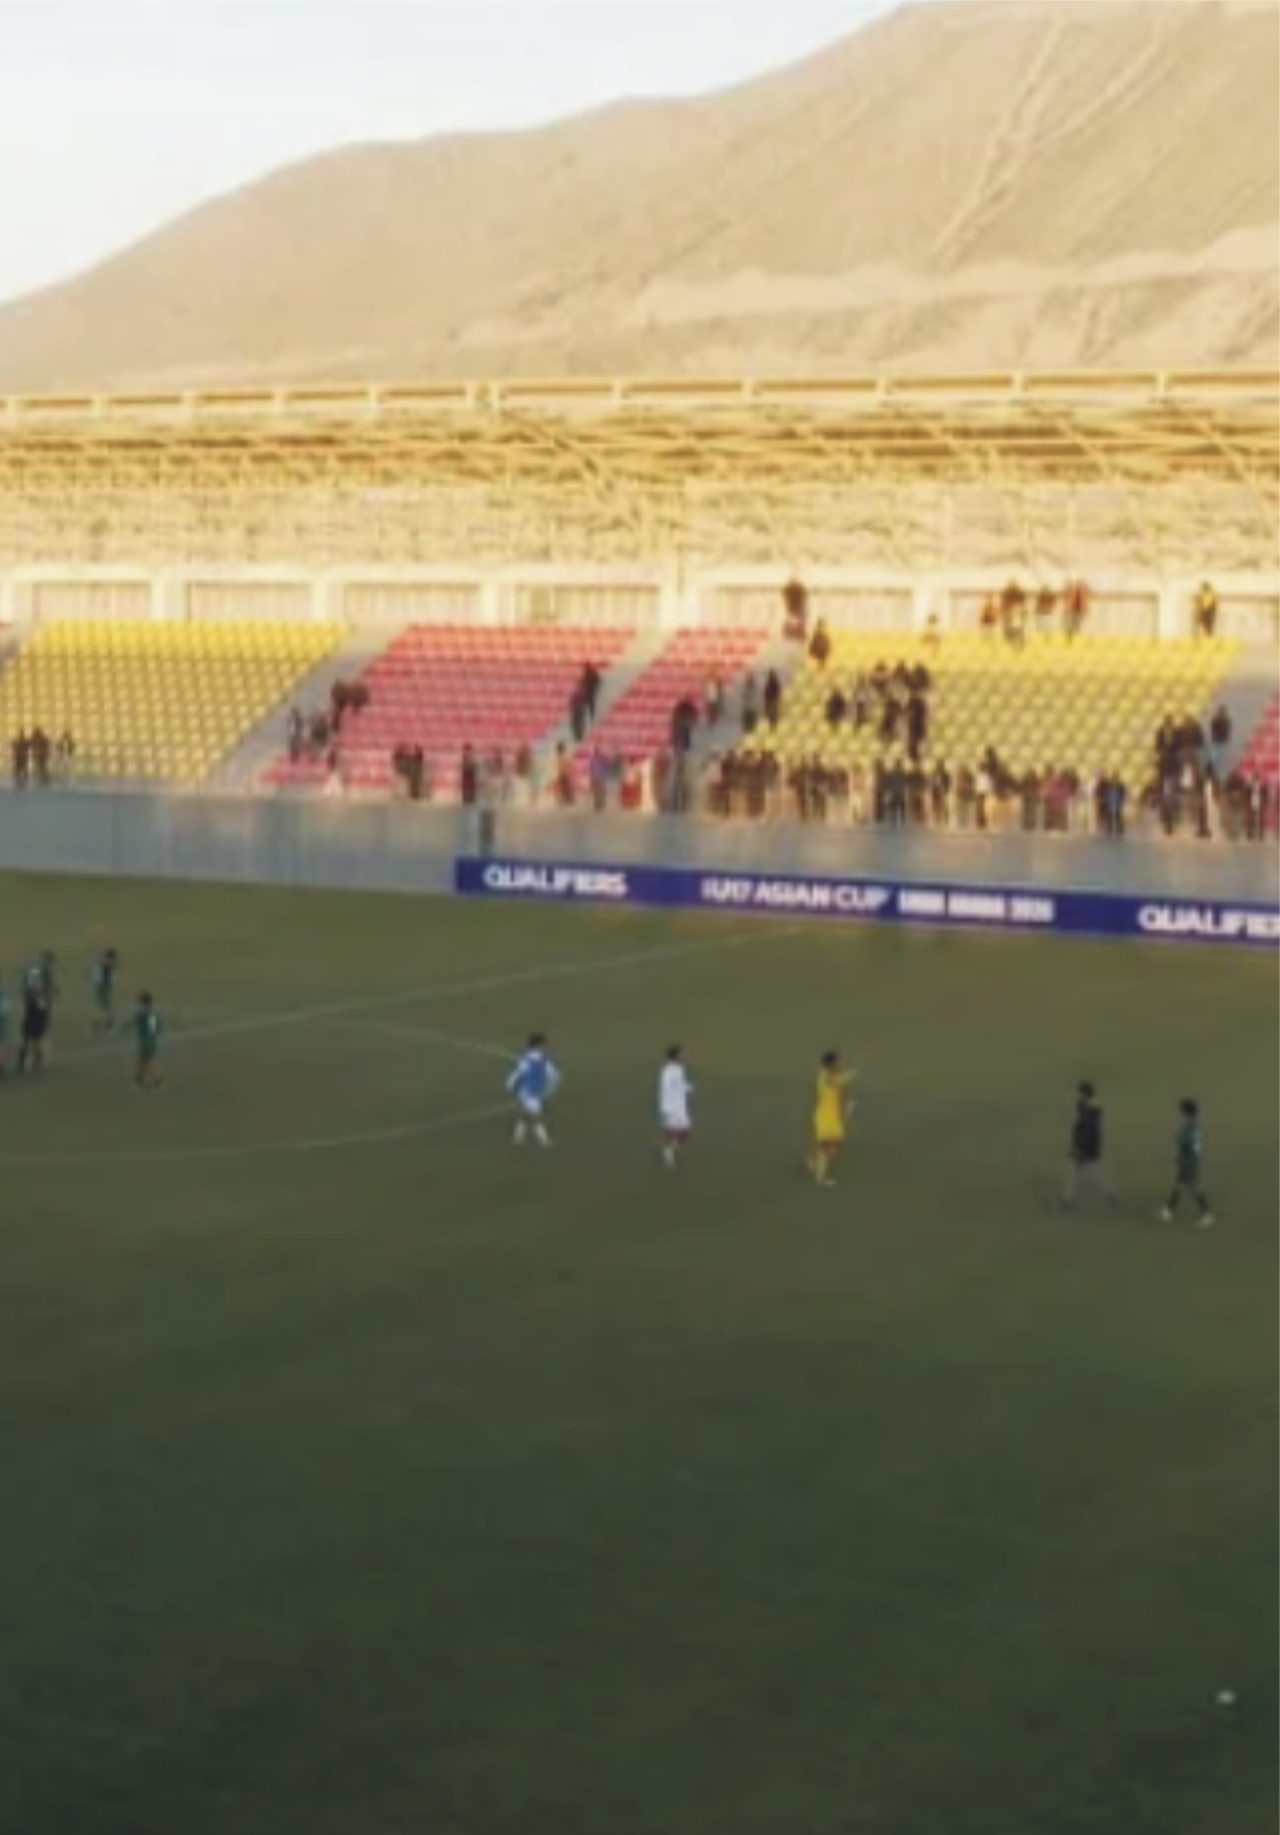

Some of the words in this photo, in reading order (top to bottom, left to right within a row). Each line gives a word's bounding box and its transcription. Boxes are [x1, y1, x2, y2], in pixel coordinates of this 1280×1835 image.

[483, 866, 627, 895] QUALIFIERS
[754, 880, 830, 907] ASIAN
[835, 885, 889, 911] CUP
